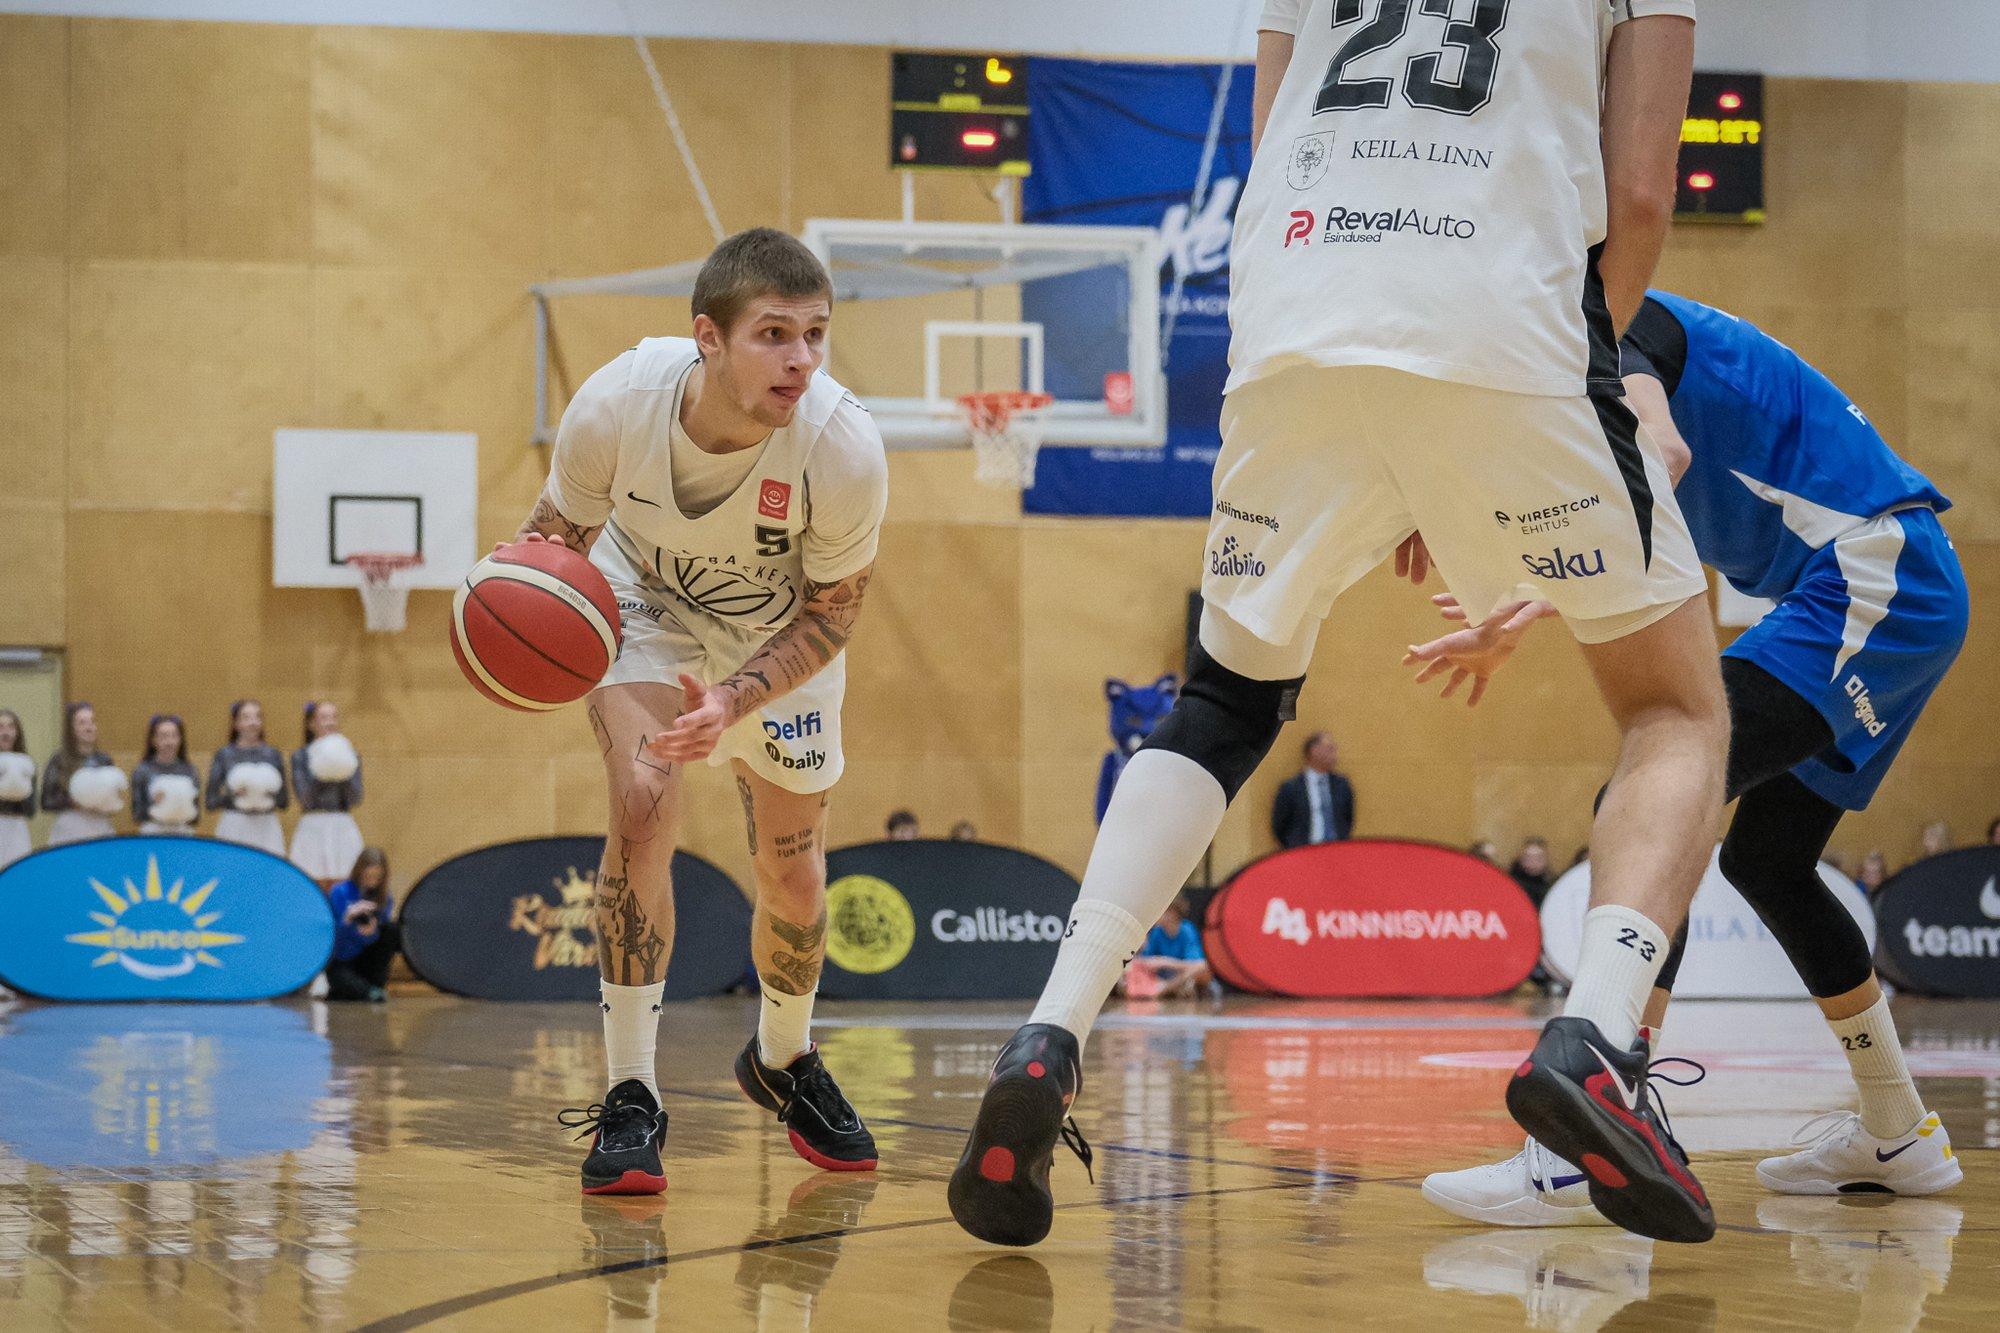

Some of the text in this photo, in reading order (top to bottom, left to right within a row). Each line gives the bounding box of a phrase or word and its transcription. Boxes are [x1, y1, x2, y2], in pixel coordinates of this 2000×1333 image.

[1312, 0, 1508, 117] 23
[1350, 139, 1494, 169] KEILA LINN
[1323, 231, 1382, 244] Esindused
[1325, 206, 1475, 239] RevalAuto
[1516, 494, 1601, 524] VIRESTCON
[755, 523, 791, 557] 5
[1521, 517, 1570, 535] EHITUS
[1521, 547, 1607, 580] saku
[762, 711, 821, 740] Delfi
[782, 749, 826, 771] Daily
[931, 906, 1065, 942] Callisto
[1316, 909, 1508, 940] KINNISVARA
[1617, 927, 1656, 963] 23
[1842, 1033, 1872, 1050] 23
